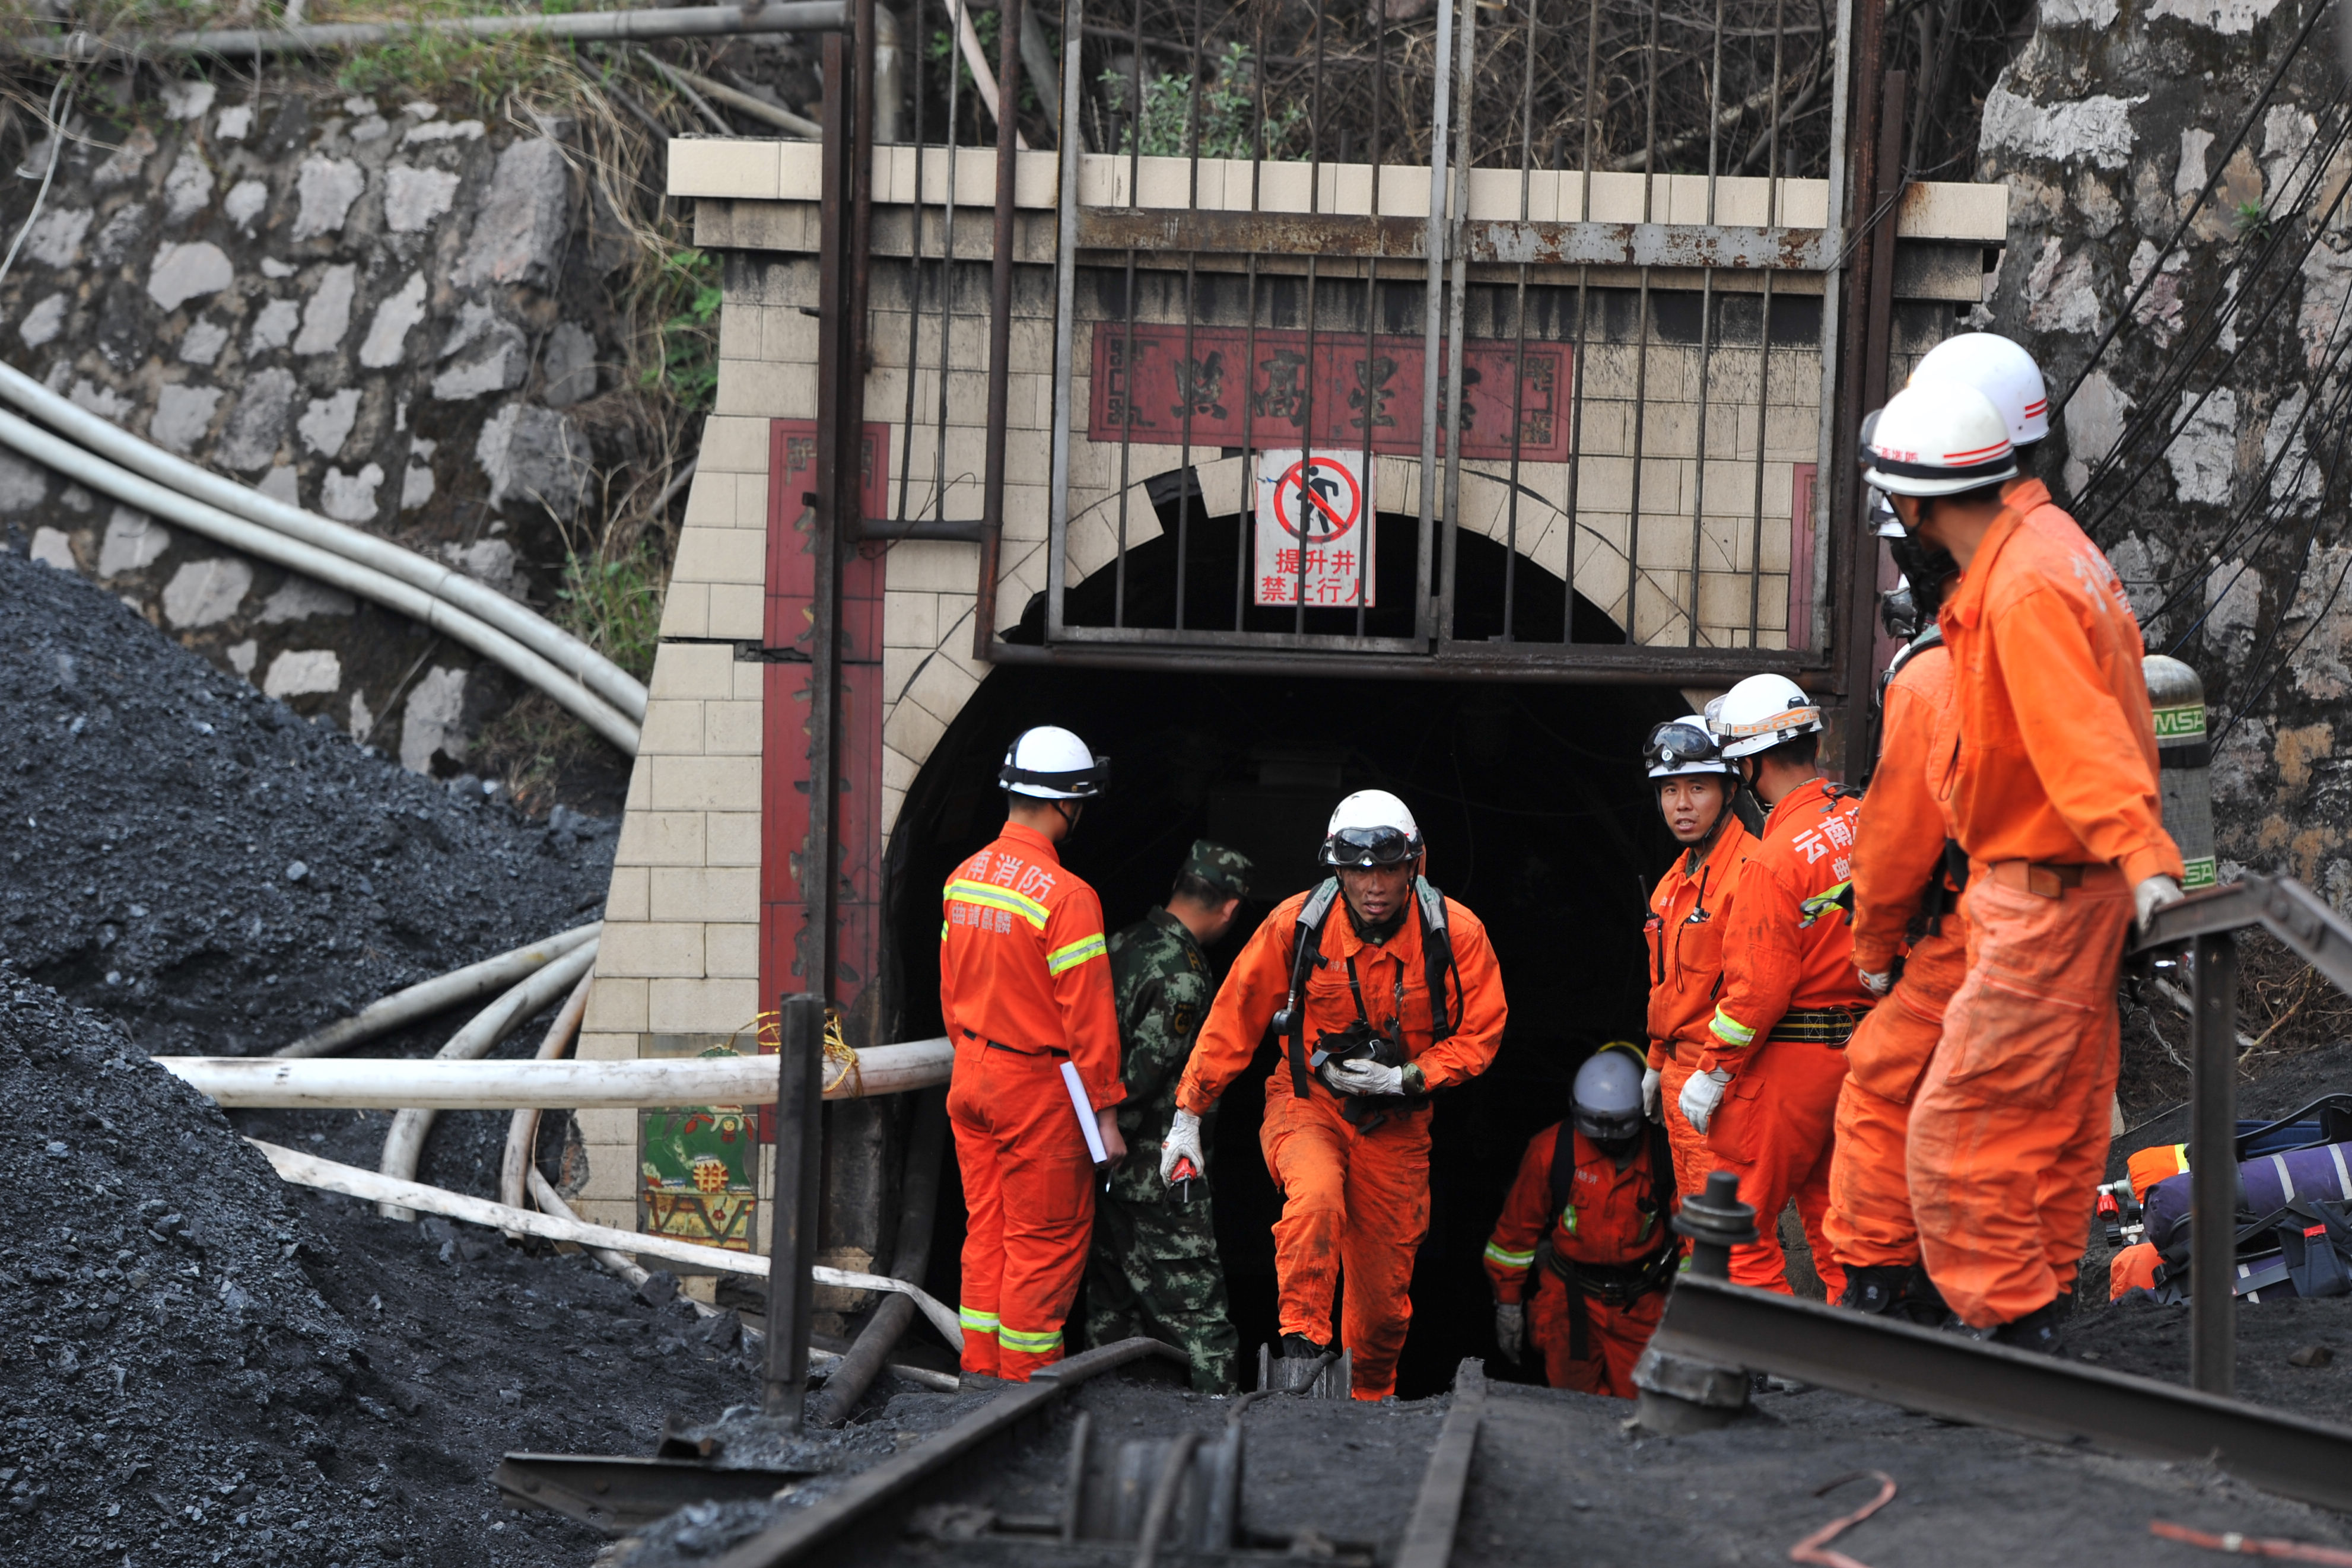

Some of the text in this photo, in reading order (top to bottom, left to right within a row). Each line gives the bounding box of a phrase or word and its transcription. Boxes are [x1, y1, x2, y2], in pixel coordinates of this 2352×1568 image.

[1276, 548, 1356, 575] 提升井
[1261, 575, 1369, 603] 禁止行人
[2153, 710, 2205, 732] MSA
[954, 850, 1057, 903] 南消防
[2182, 864, 2214, 883] SA
